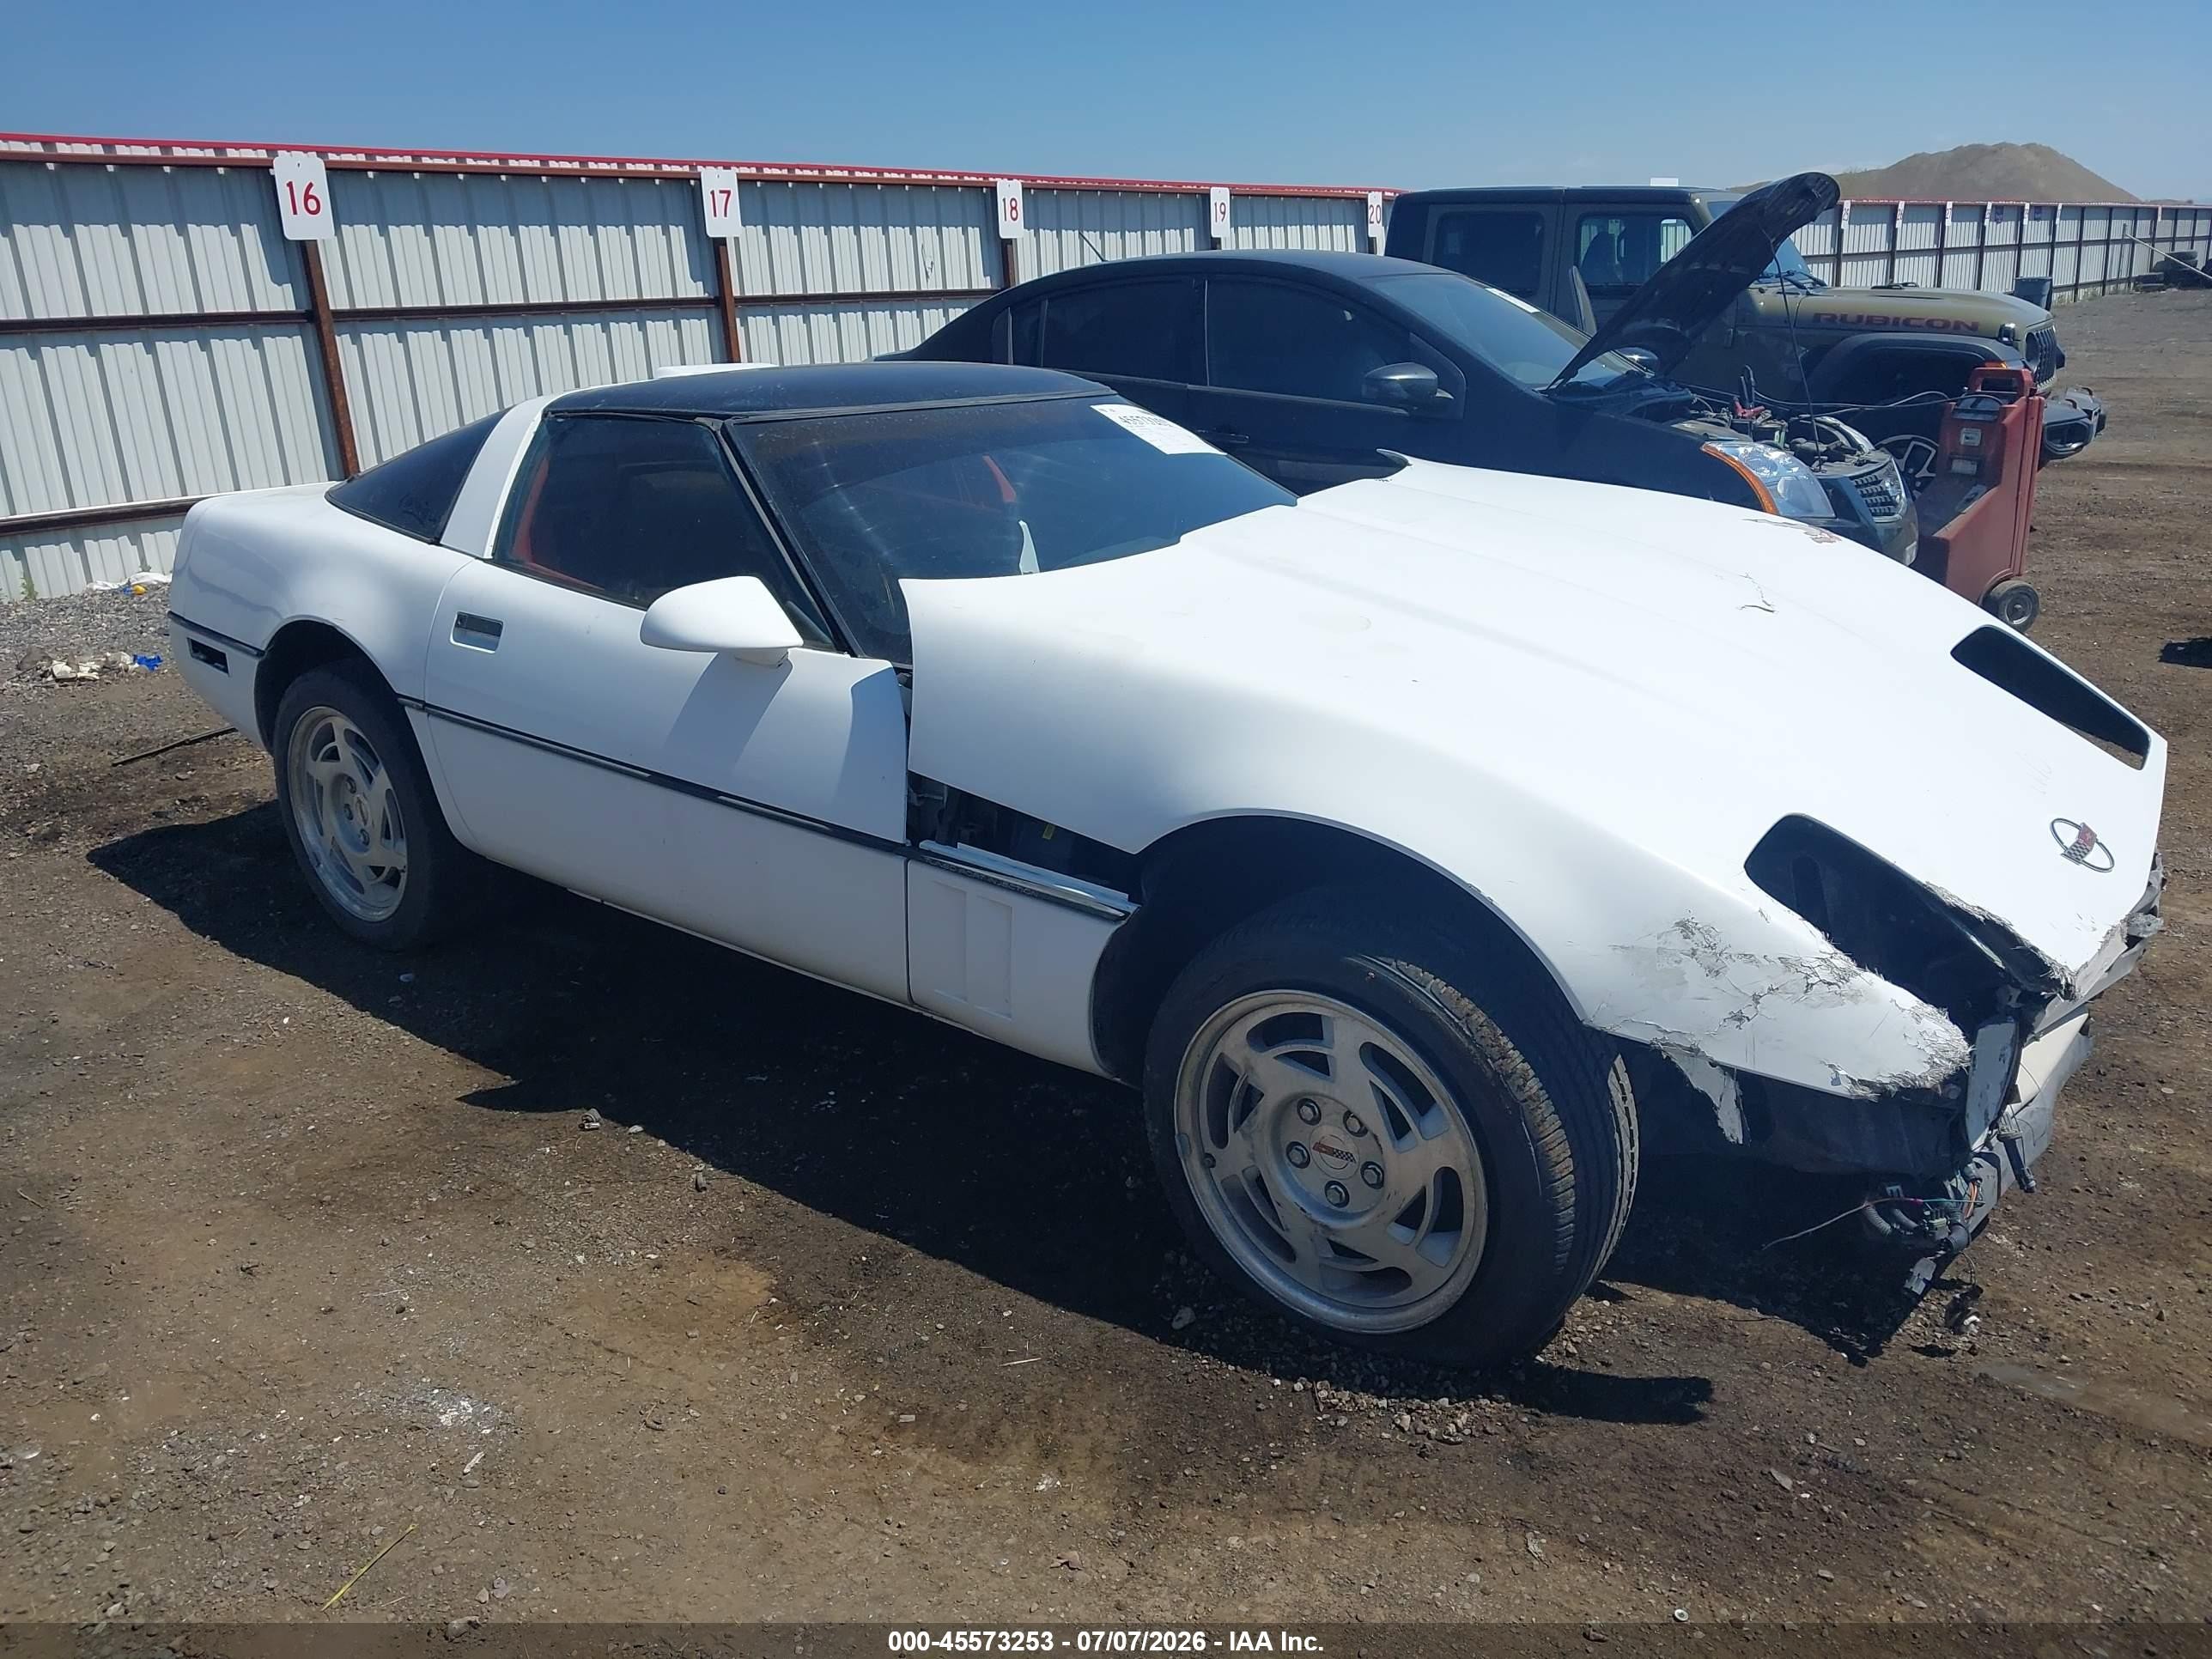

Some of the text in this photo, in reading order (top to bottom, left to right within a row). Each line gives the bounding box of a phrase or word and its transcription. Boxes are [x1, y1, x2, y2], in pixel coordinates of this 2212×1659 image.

[286, 180, 321, 216] 16
[709, 189, 732, 218] 17
[1002, 197, 1018, 222] 18
[1214, 201, 1226, 222] 19
[1369, 204, 1382, 224] 20
[1813, 312, 1979, 331] RUBICON
[958, 866, 986, 880] PORT
[987, 878, 1039, 898] INJECTION
